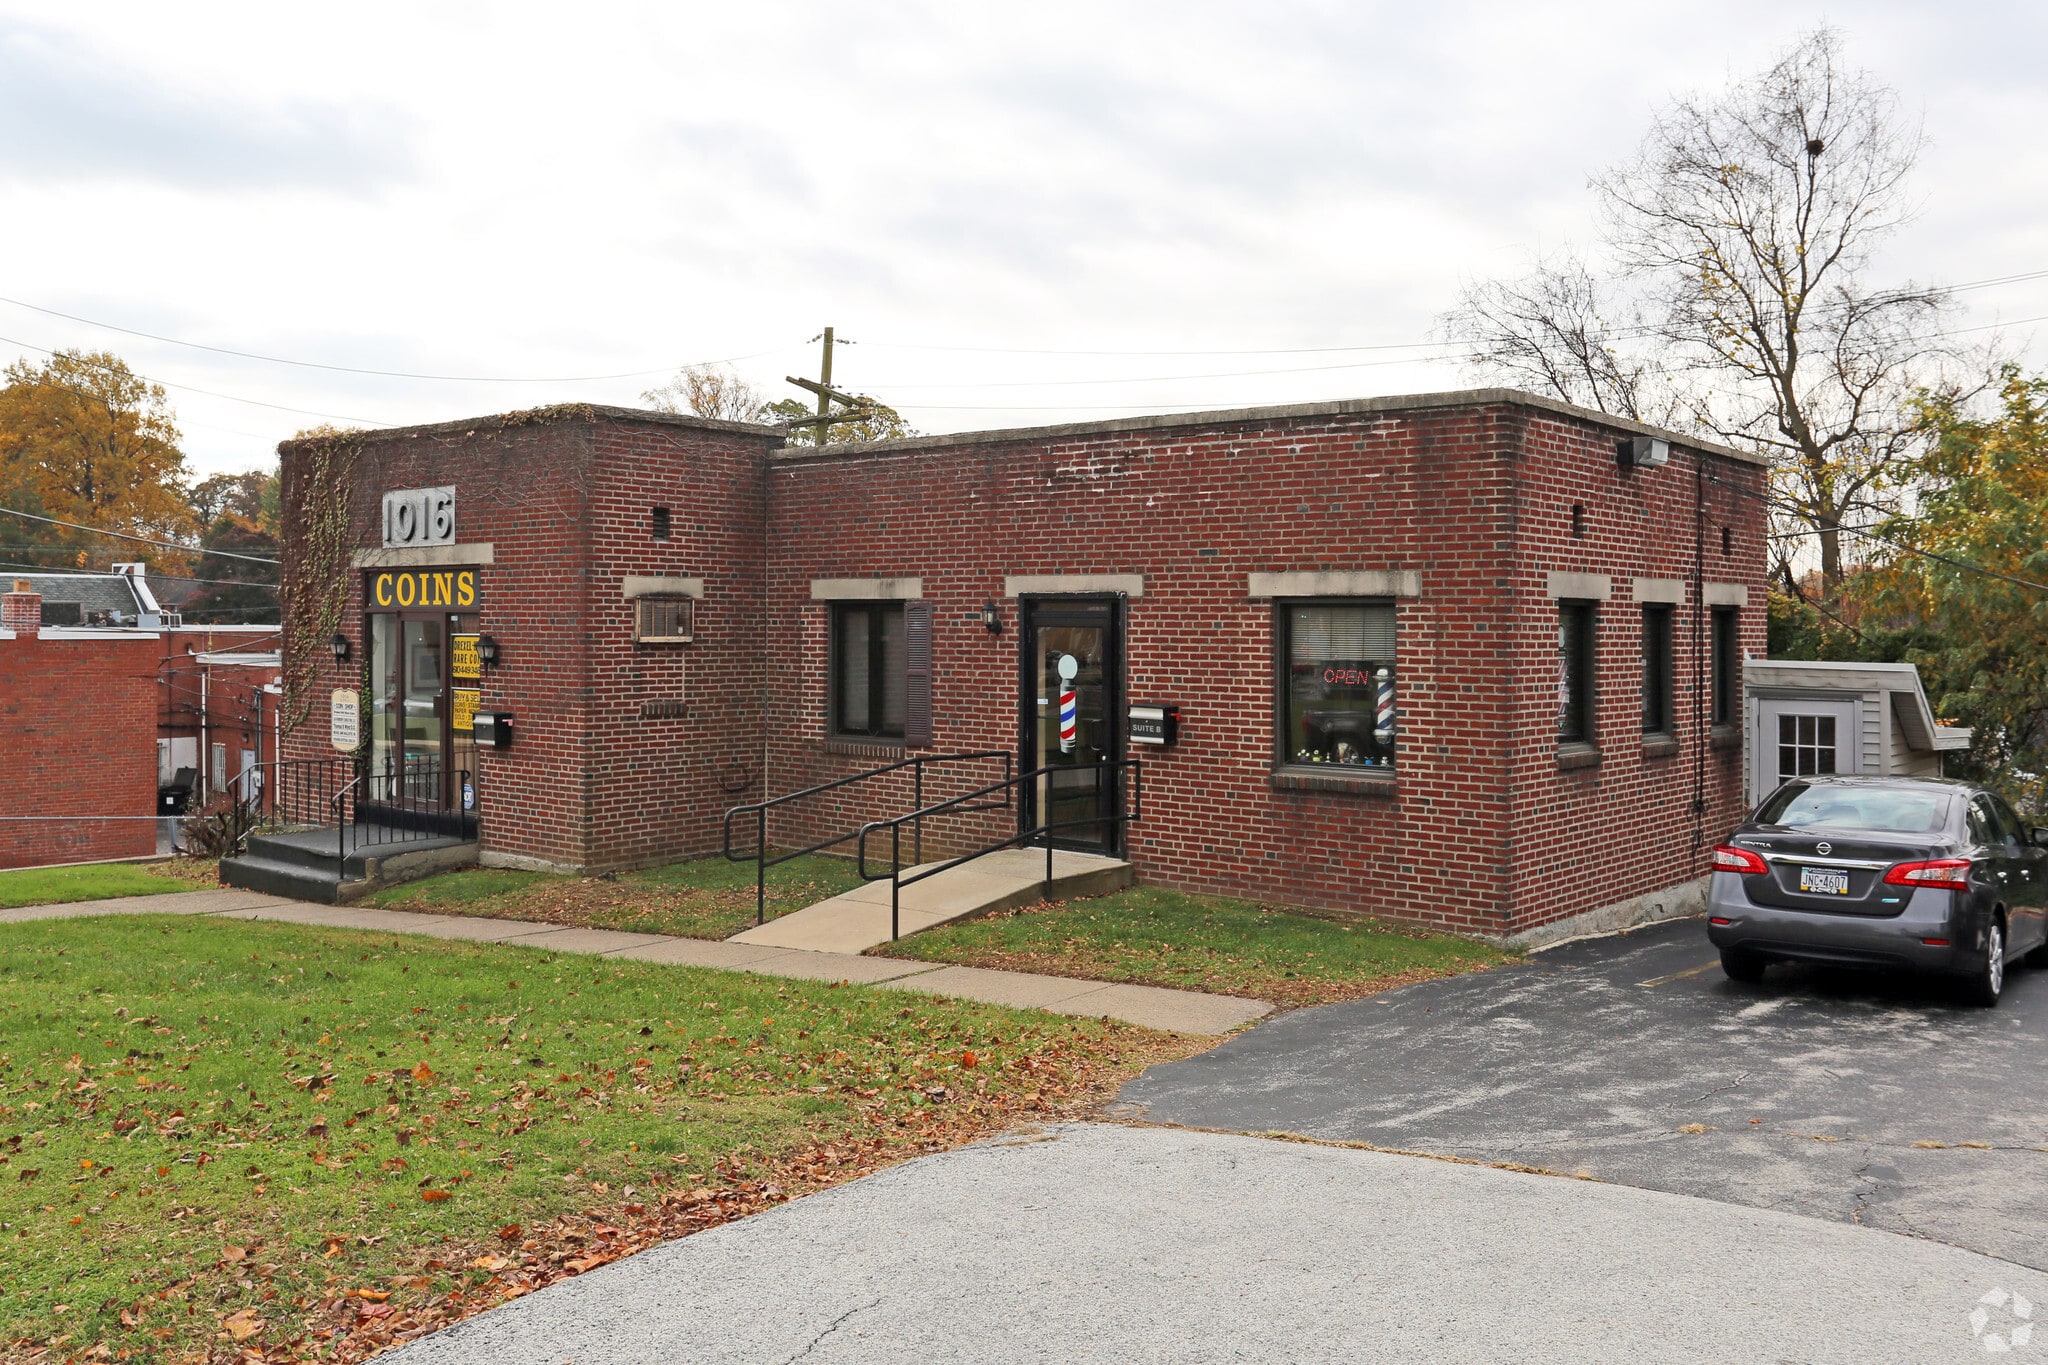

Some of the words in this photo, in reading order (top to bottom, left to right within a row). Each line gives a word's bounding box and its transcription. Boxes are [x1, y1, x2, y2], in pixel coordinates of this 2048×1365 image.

[384, 492, 453, 543] 1016
[376, 571, 475, 607] COINS
[454, 653, 468, 664] RARE
[1323, 669, 1369, 685] OPEN
[1132, 724, 1154, 732] SUITE
